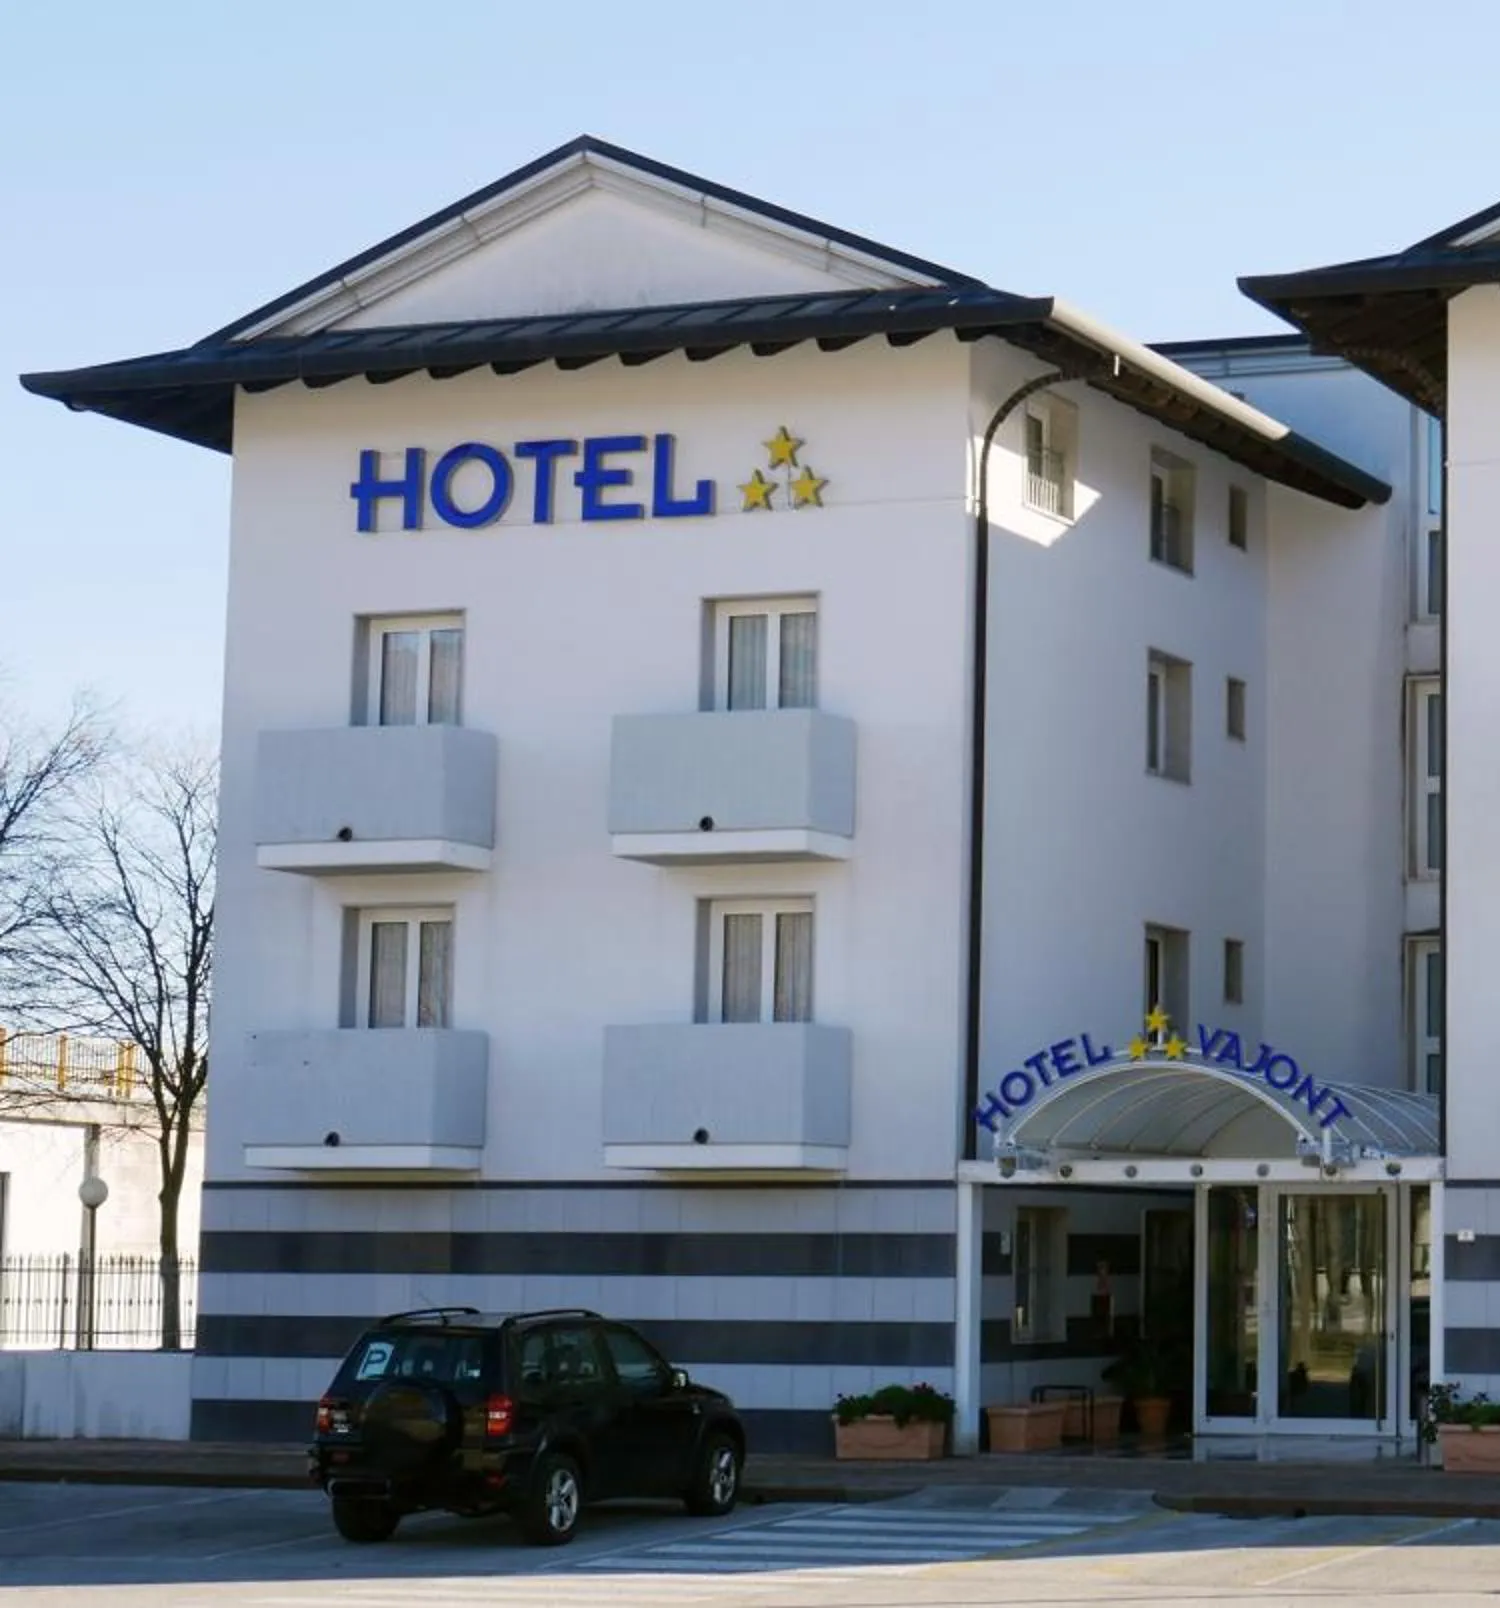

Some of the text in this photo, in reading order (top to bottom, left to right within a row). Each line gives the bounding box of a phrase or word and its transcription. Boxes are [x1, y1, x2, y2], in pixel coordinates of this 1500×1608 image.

[350, 433, 716, 532] HOTEL
[973, 1023, 1352, 1133] HOTEL VAJONT
[362, 1350, 387, 1375] P
